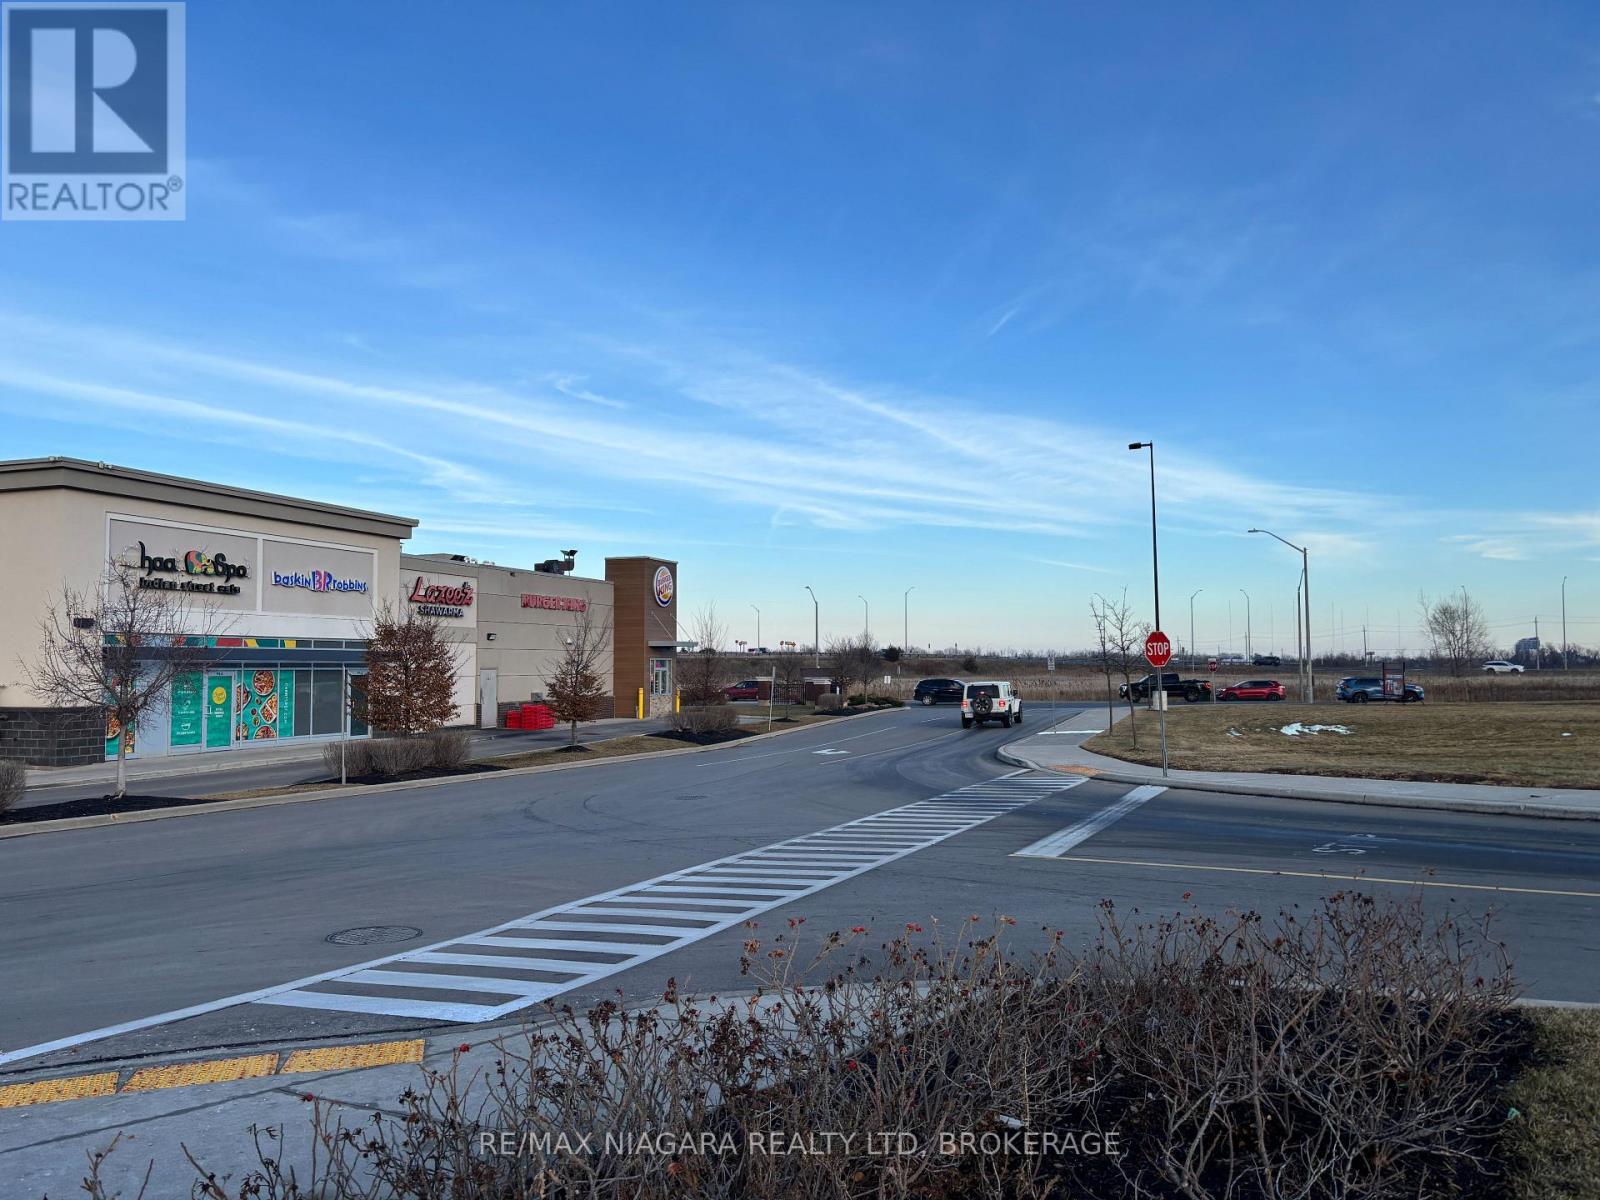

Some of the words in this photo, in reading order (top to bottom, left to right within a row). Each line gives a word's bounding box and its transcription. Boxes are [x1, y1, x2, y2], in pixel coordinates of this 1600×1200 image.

[271, 570, 311, 588] baskin
[332, 577, 368, 594] robbins
[1147, 642, 1169, 656] STOP
